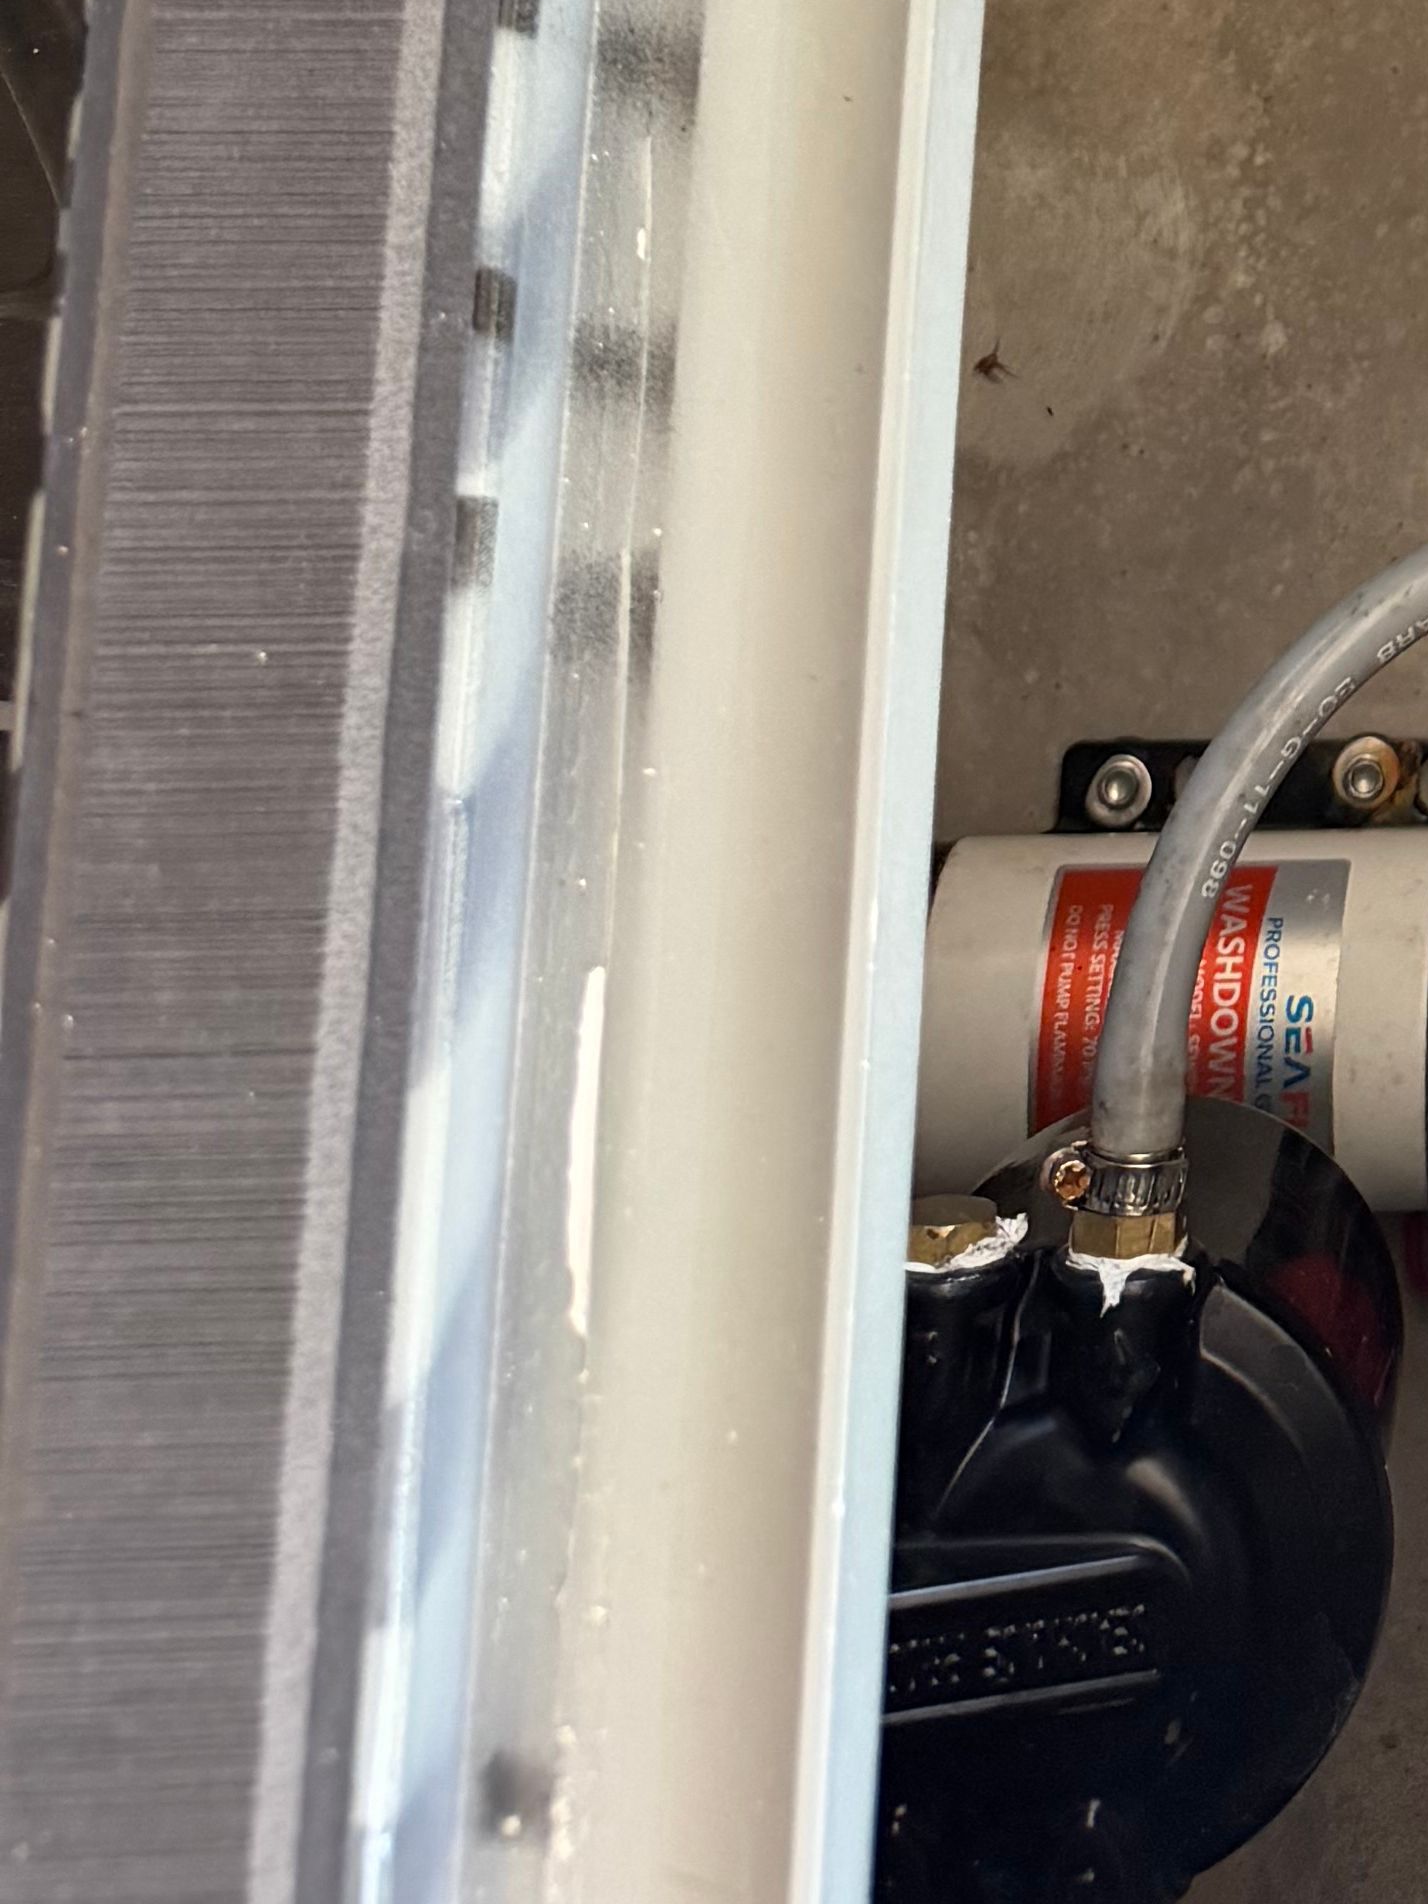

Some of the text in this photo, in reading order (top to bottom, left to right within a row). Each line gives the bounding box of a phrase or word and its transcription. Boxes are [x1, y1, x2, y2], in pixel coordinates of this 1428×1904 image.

[1066, 905, 1083, 926] DO
[1092, 904, 1114, 951] PRESS
[1062, 928, 1080, 960] NOT
[1054, 962, 1075, 1010] PUMP
[1084, 953, 1106, 1031] SETTING:
[1206, 884, 1253, 1099] WASHDOWN
[1254, 917, 1284, 1089] PROFESSIONAL
